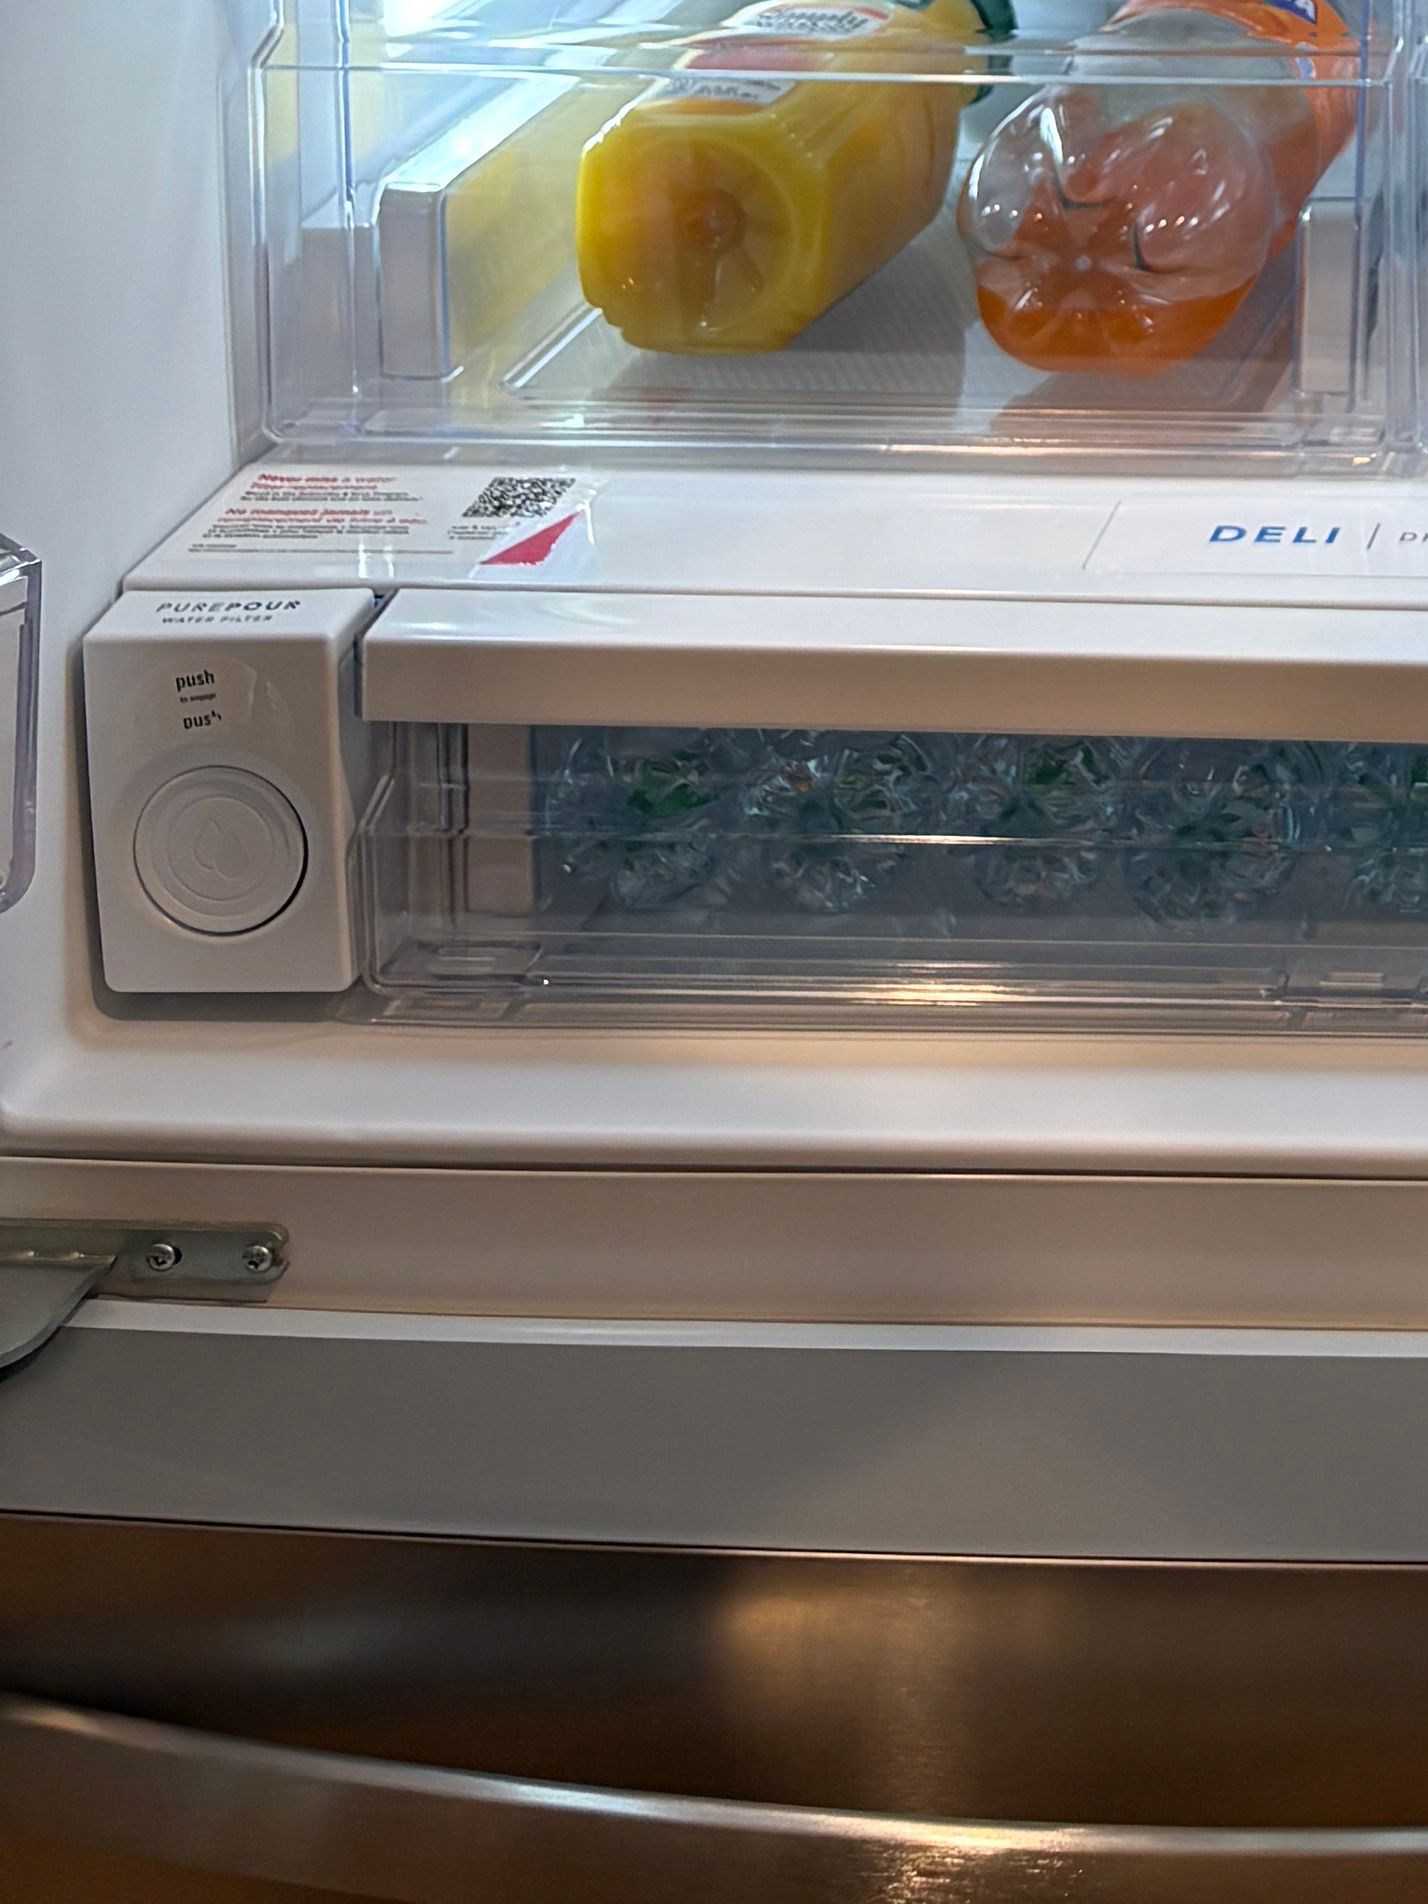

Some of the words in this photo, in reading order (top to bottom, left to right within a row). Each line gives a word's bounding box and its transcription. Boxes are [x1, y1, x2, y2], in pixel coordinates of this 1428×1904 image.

[1209, 526, 1342, 545] DELI
[155, 599, 302, 614] PUREPOUR
[175, 669, 216, 692] push
